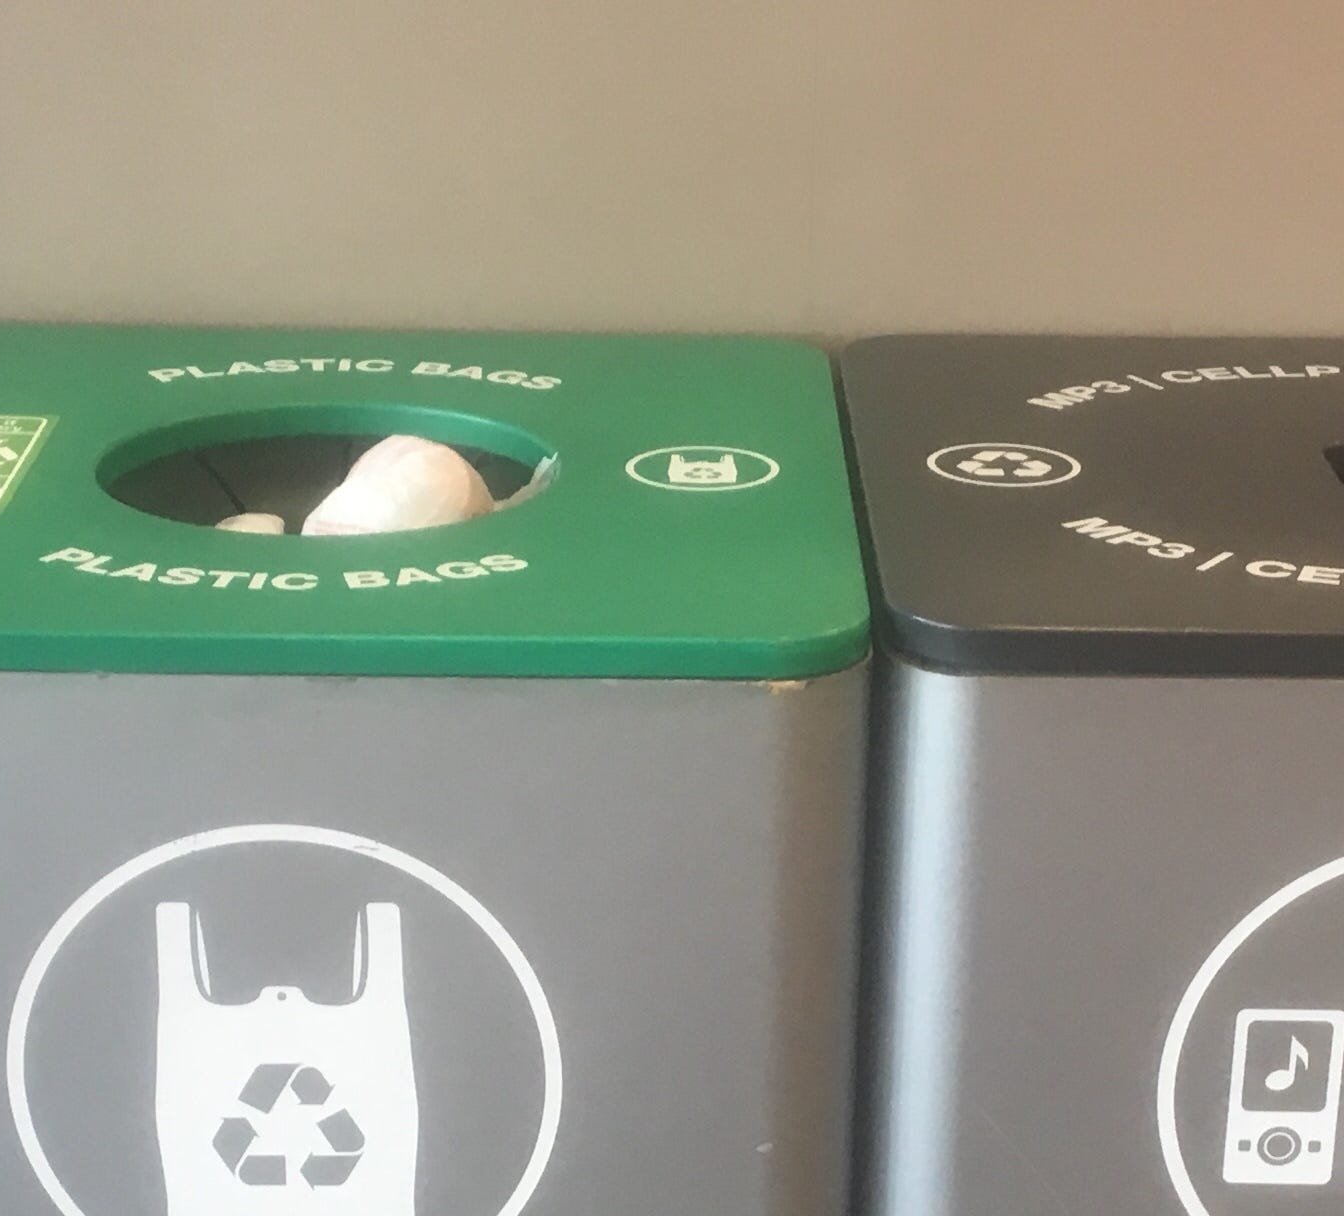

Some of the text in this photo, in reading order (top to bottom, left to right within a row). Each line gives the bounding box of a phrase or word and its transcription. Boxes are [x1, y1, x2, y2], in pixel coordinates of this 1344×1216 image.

[146, 358, 563, 391] PLASTIC BAGS
[1027, 379, 1132, 410] MP3
[1060, 516, 1196, 559] MP3
[38, 546, 531, 592] PLASTIC BAGS
